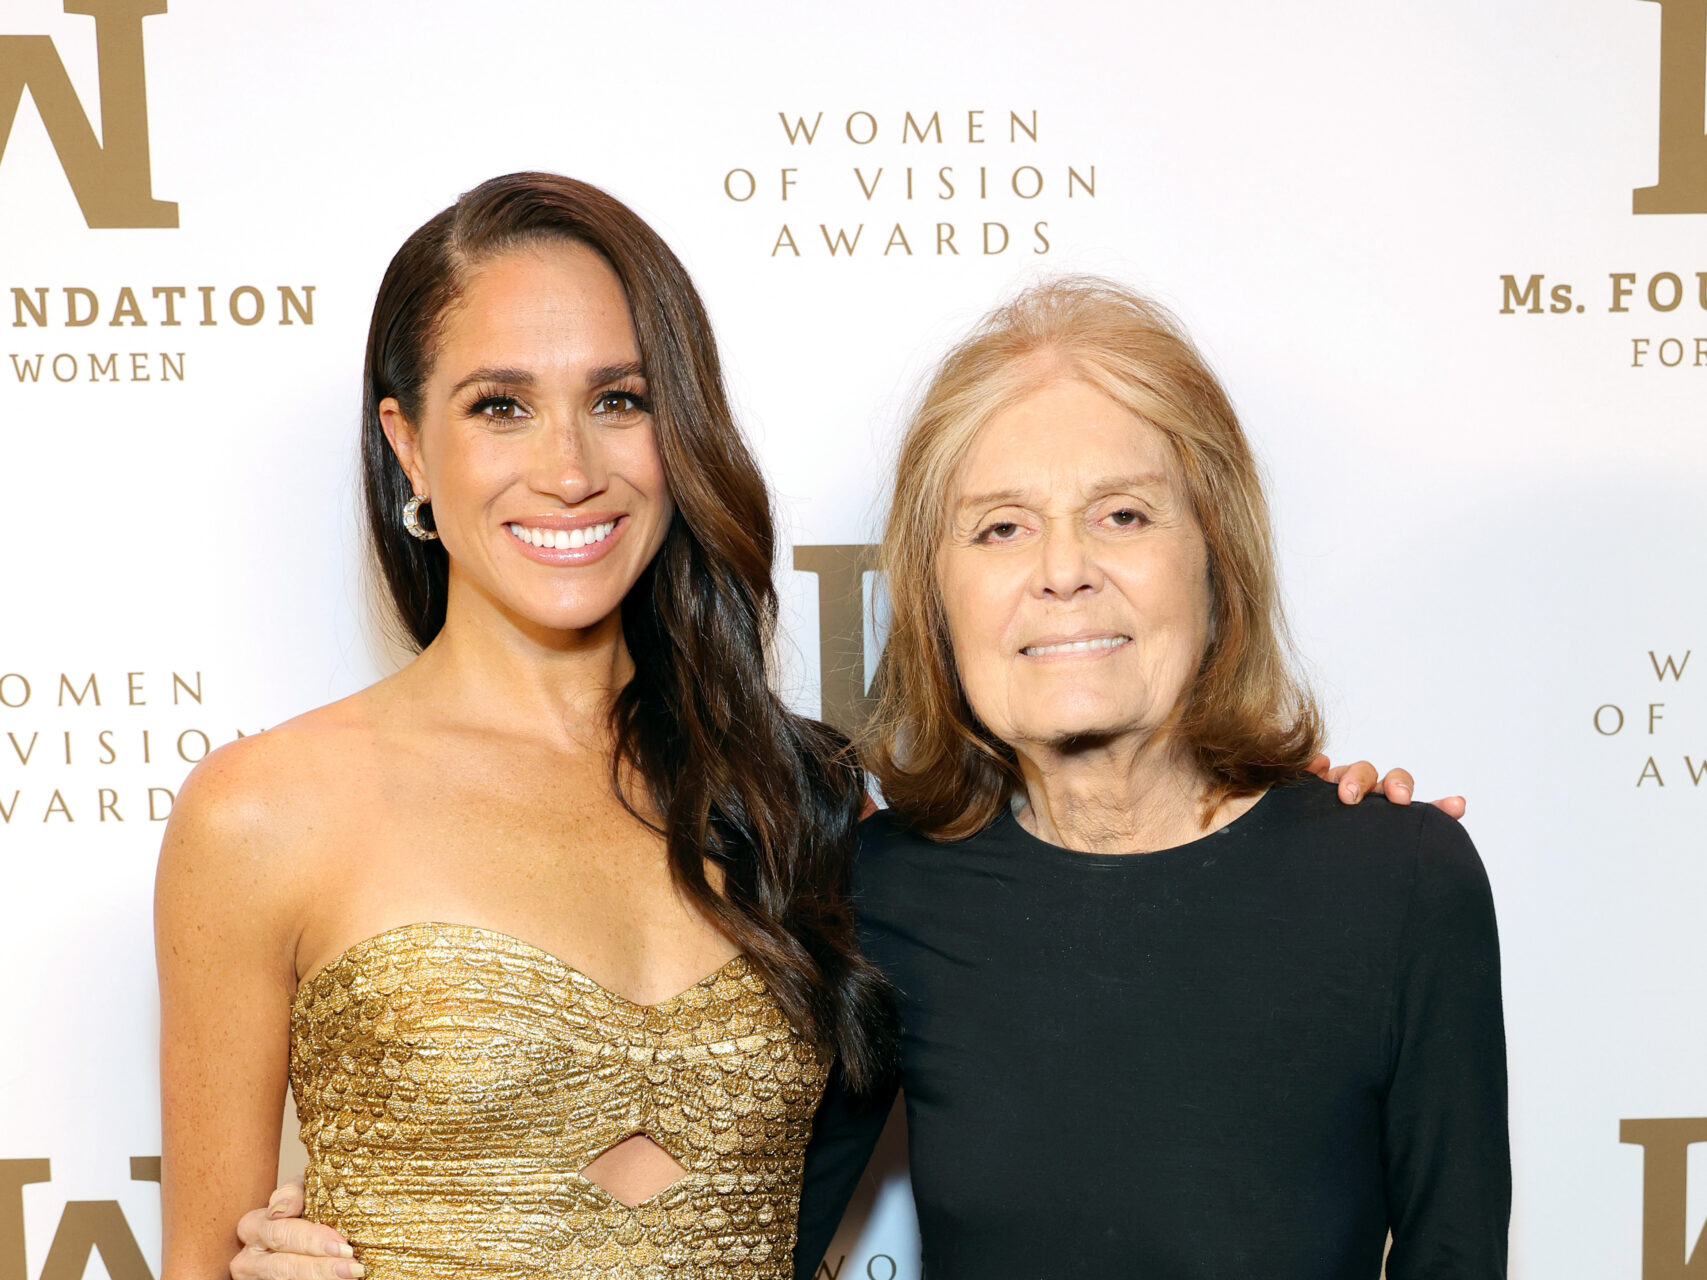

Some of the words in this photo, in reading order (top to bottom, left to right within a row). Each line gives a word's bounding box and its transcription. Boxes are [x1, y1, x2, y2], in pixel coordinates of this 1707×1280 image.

[778, 109, 1038, 146] WOMEN
[723, 168, 799, 202] OF
[853, 165, 1095, 201] VISION
[771, 221, 1050, 257] AWARDS
[9, 285, 317, 328] NDATION
[1499, 273, 1586, 315] Ms.
[8, 352, 187, 383] WOMEN
[1593, 703, 1665, 736] OF
[7, 728, 265, 766] VISIO
